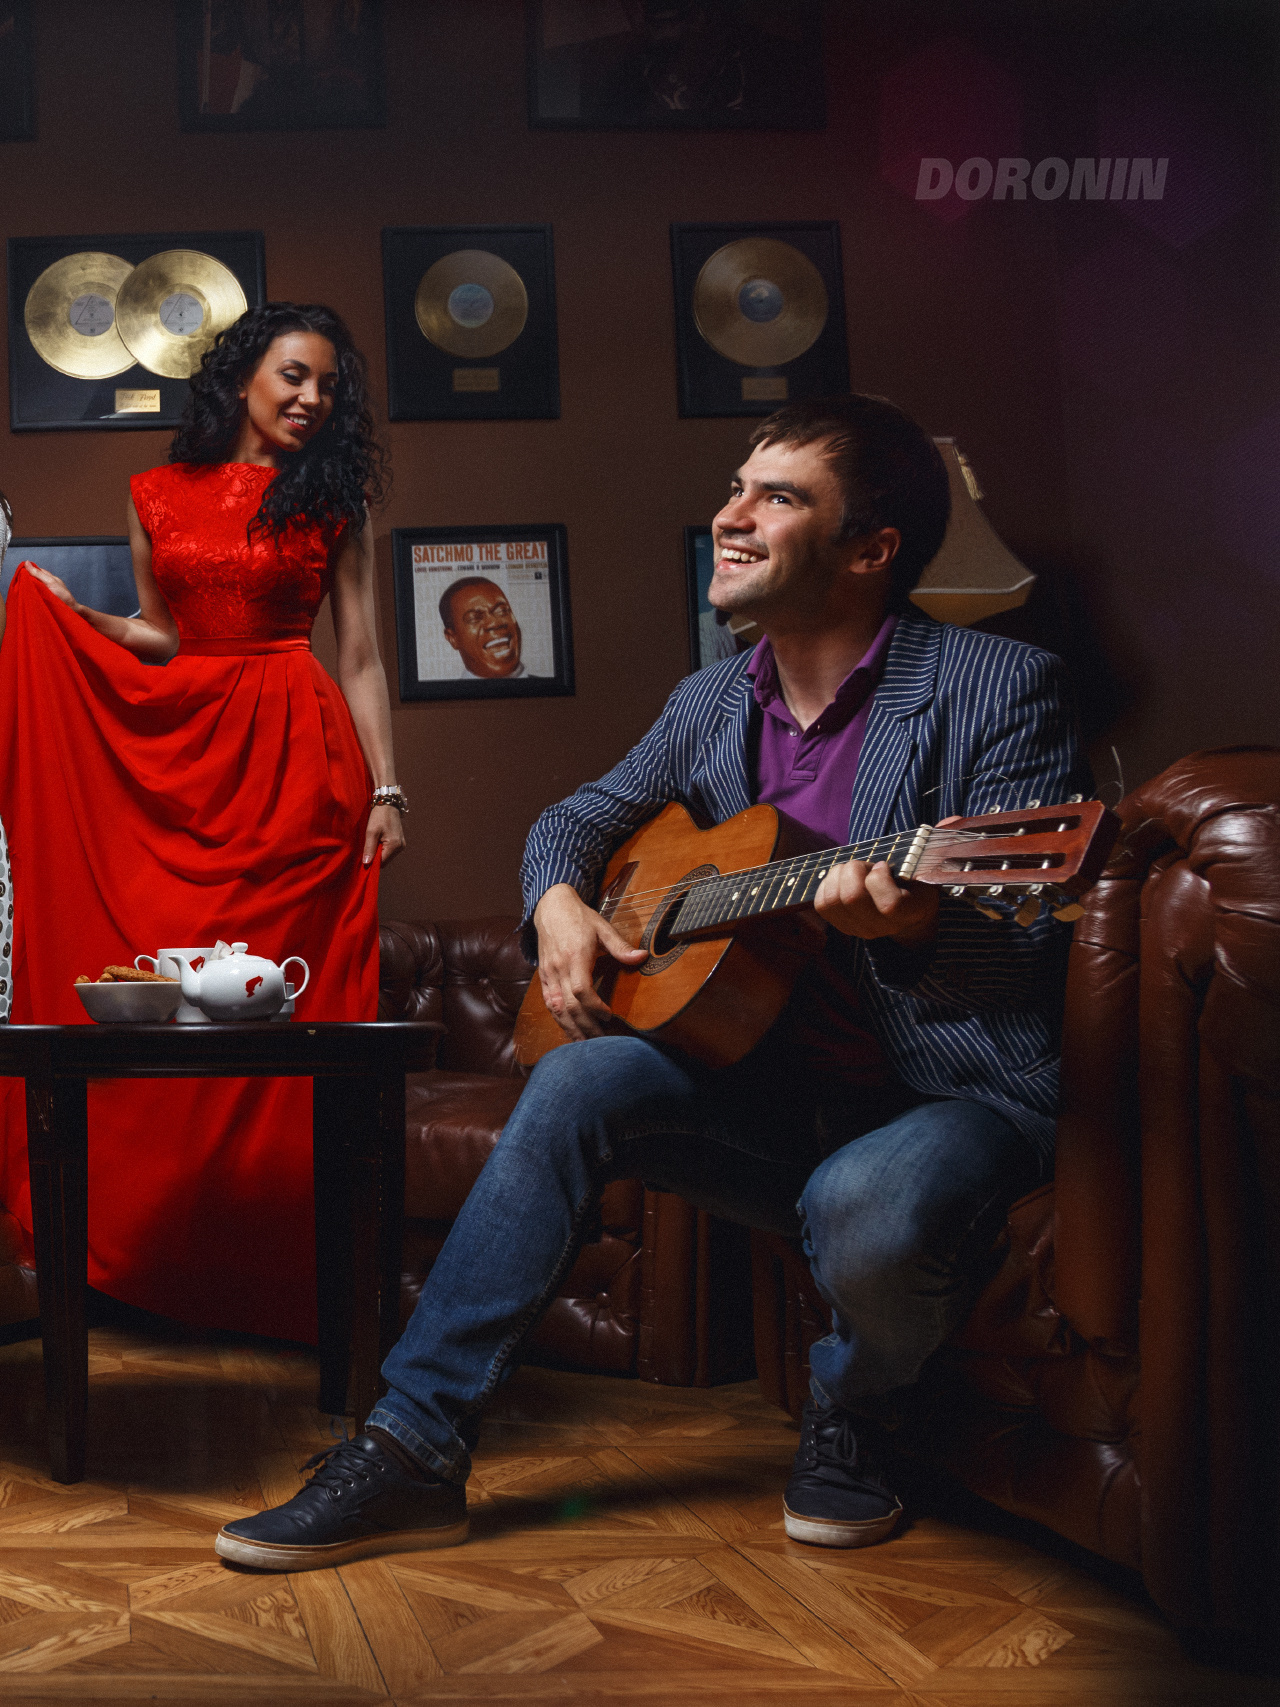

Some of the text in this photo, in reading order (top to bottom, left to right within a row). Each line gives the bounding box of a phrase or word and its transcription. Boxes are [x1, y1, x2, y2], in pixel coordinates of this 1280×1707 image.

[414, 542, 547, 563] SATCHMO THE GREAT
